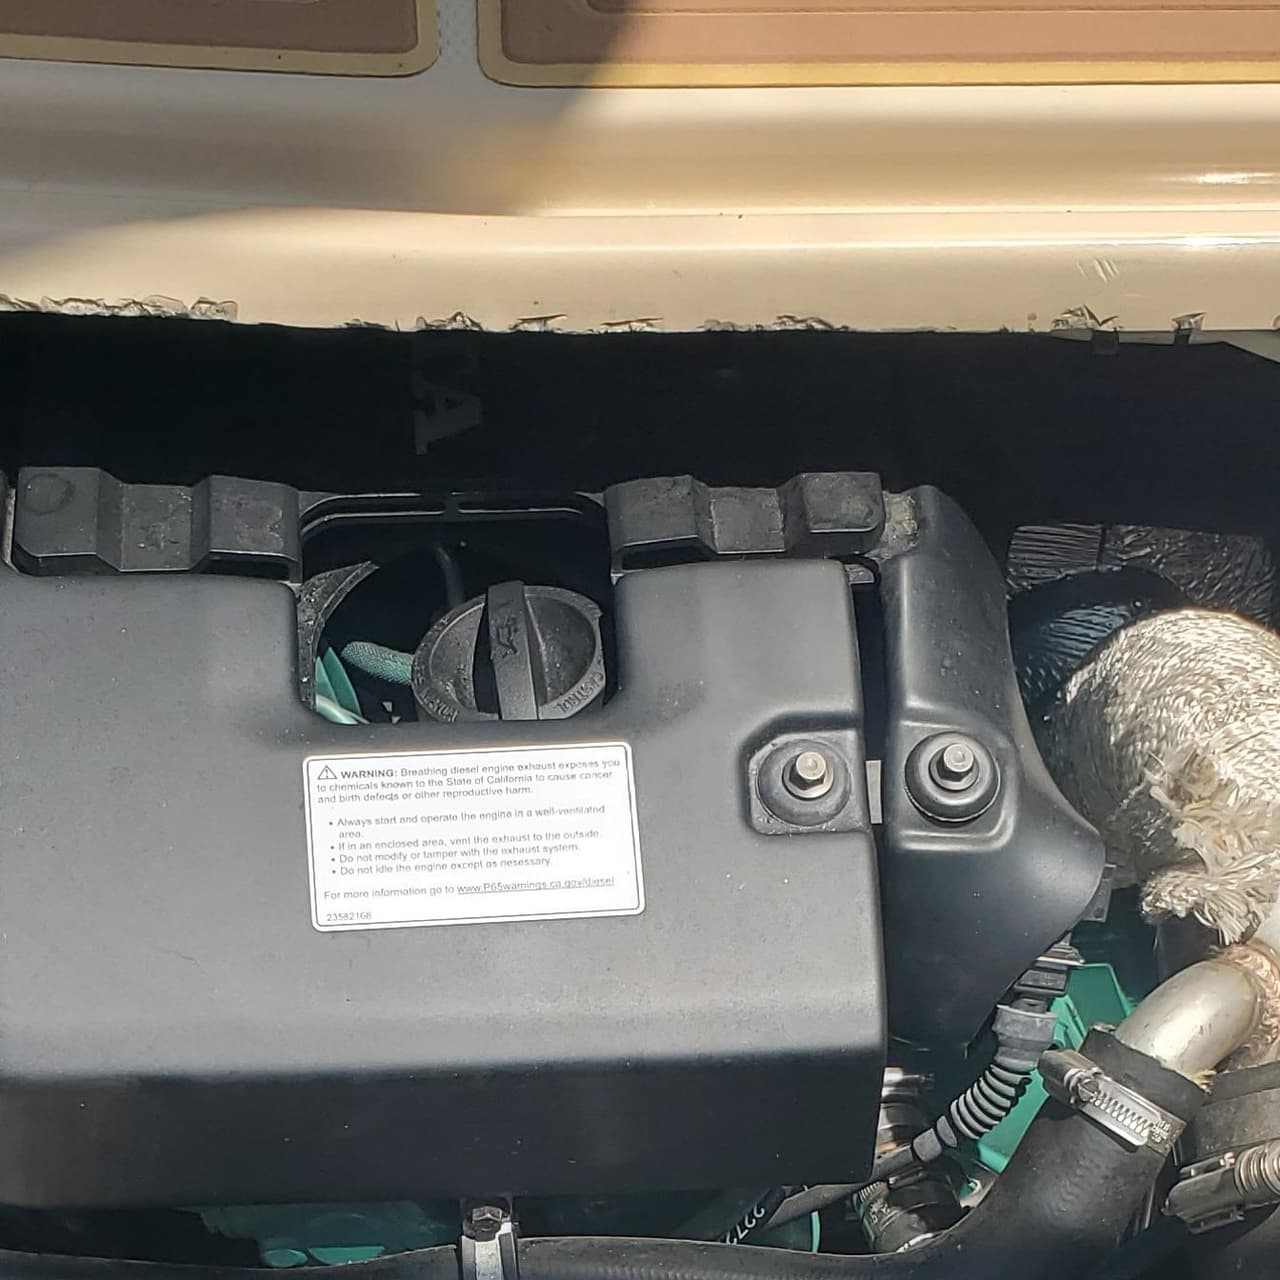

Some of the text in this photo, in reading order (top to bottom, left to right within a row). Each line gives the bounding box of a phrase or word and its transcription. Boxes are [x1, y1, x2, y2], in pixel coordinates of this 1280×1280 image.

[341, 760, 620, 779] WARNING: Breathing diesel engine exhaust exposes you
[317, 770, 612, 792] to chemicals known to the State of California to cause cancer
[318, 795, 336, 804] and
[339, 793, 360, 802] birth
[363, 792, 399, 802] defects
[414, 789, 440, 798] other
[442, 787, 503, 799] reproductive
[506, 785, 532, 794] harm.
[337, 817, 372, 828] Always
[375, 815, 396, 825] start
[399, 814, 418, 823] and
[421, 813, 458, 824] operate
[461, 811, 476, 821] the
[479, 810, 512, 821] engine
[514, 808, 523, 817] in
[535, 805, 605, 816] well-ventilated
[339, 829, 364, 839] area.
[339, 841, 347, 851] If
[349, 841, 356, 849] in
[359, 841, 372, 849] an
[375, 838, 419, 848] enclosed
[422, 838, 448, 847] area,
[450, 836, 470, 845] vent
[472, 834, 489, 843] the
[492, 833, 530, 842] exhaust
[533, 832, 542, 840] to
[545, 830, 561, 840] the
[339, 854, 353, 863] Do
[356, 853, 372, 862] not
[375, 850, 408, 863] modify
[410, 851, 420, 859] or
[423, 848, 458, 859] tamper
[461, 847, 480, 857] with
[483, 846, 498, 855] the
[501, 844, 540, 854] exhaust
[340, 866, 355, 875] Do
[357, 865, 373, 874] not
[375, 864, 393, 873] idle
[396, 863, 412, 872] the
[414, 862, 448, 872] engine
[451, 859, 482, 871] except
[324, 891, 339, 900] For
[342, 890, 368, 898] more
[371, 887, 426, 897] information
[429, 887, 442, 896] go
[445, 885, 454, 894] to
